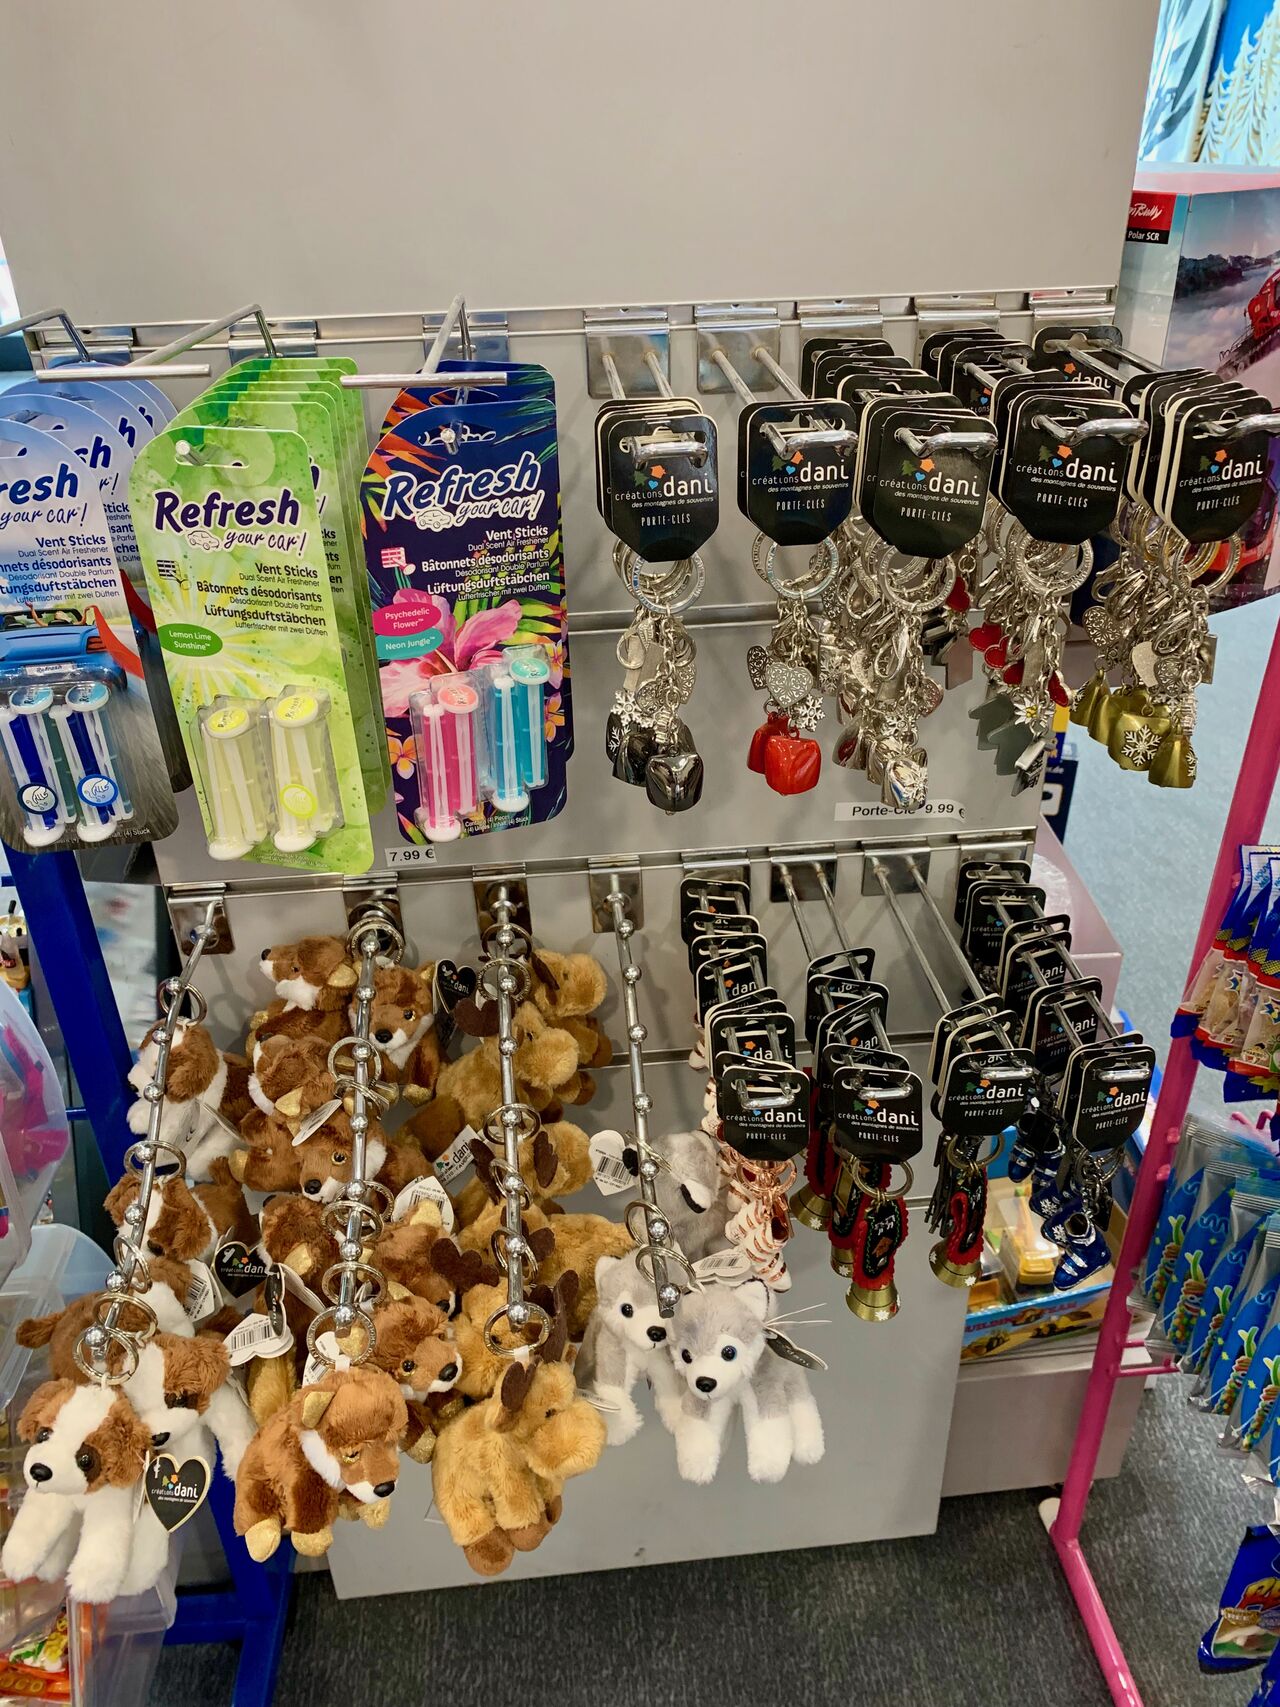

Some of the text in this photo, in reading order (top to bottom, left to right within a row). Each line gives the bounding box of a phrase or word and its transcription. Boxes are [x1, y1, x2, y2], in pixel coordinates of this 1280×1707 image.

[1128, 202, 1163, 221] nBully
[1128, 230, 1160, 241] Polar SCR
[752, 459, 849, 486] créations dani
[1016, 458, 1118, 483] créations dani
[1180, 454, 1263, 487] créations dani
[383, 452, 542, 518] Refresh
[615, 473, 714, 501] créations dani
[780, 484, 812, 492] montagnes
[879, 472, 980, 497] créations dani
[1043, 478, 1076, 487] montagnes
[1087, 484, 1117, 492] souvenirs
[644, 500, 676, 508] montagnes
[906, 493, 939, 501] montagnes
[950, 497, 979, 505] souvenirs
[154, 488, 300, 533] Refresh
[456, 501, 499, 524] your
[0, 511, 42, 530] your
[224, 532, 265, 548] your
[486, 524, 548, 541] Vent Sticks
[35, 534, 106, 548] Vent Sticks
[468, 537, 549, 552] Dual Scent Air Freshener
[18, 550, 36, 558] Dual
[38, 548, 59, 556] Scent
[73, 546, 108, 554] Freshener
[32, 556, 112, 570] désodorisants
[421, 548, 549, 572] Bâtonnets désodorisants
[500, 563, 525, 572] Double
[526, 560, 549, 570] Parfum
[59, 570, 86, 578] Double
[88, 568, 114, 576] Parfum
[255, 562, 318, 578] Vent Sticks
[240, 573, 255, 581] Dual
[287, 577, 320, 586] Freshener
[427, 572, 550, 595] Lüftungsduftstäbchen
[196, 580, 322, 602] Bâtonnets désodorisants
[528, 583, 550, 592] Düften
[64, 592, 76, 600] mit
[274, 601, 298, 609] Double
[300, 603, 324, 611] Parfum
[385, 607, 430, 620] Psychedelic
[204, 604, 326, 626] Lüftungsduftstäbchen
[169, 630, 212, 640] Lemon Lime
[290, 626, 304, 634] zwei
[385, 642, 406, 650] Neon
[925, 804, 954, 814] 9.99
[389, 848, 434, 861] 7.99 €
[732, 981, 756, 997] dan
[754, 1045, 792, 1060] dai
[986, 1084, 1024, 1099] dani
[1114, 1088, 1146, 1108] dani
[726, 1108, 806, 1123] créations dani
[838, 1108, 919, 1126] créations dani
[174, 1482, 198, 1498] dani
